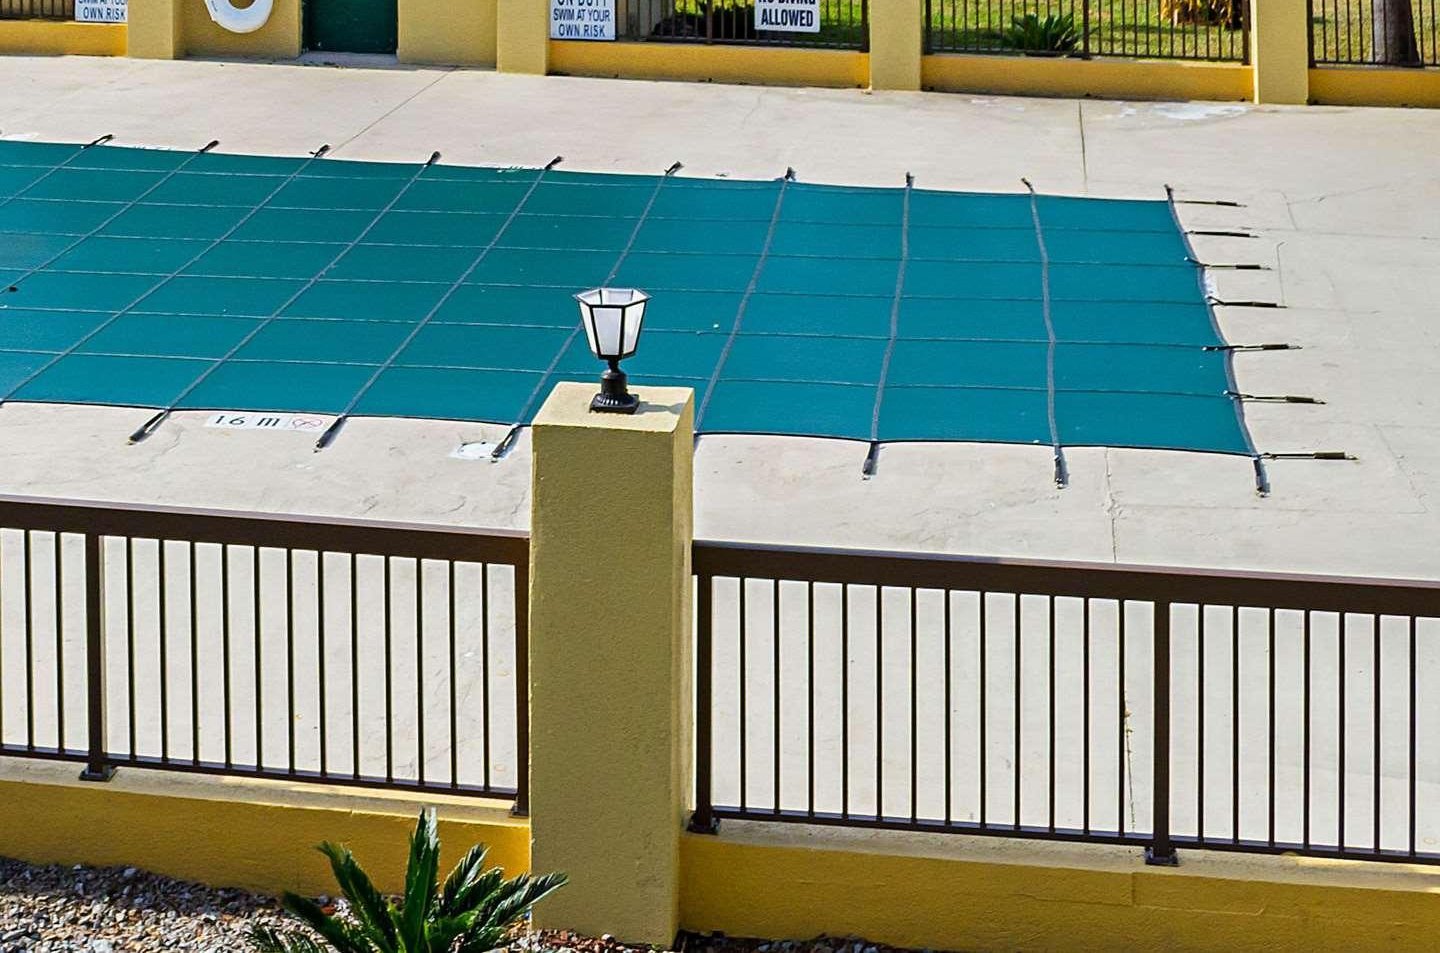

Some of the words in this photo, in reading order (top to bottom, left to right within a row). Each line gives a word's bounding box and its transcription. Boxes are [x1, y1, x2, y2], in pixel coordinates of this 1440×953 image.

[83, 7, 103, 20] OWN
[106, 8, 126, 21] RISK
[553, 8, 575, 21] SWIM
[577, 9, 586, 21] AT
[587, 9, 610, 22] YOUR
[761, 8, 814, 27] ALLOWED
[558, 23, 580, 36] OWN
[583, 25, 606, 38] RISK
[256, 417, 281, 427] m
